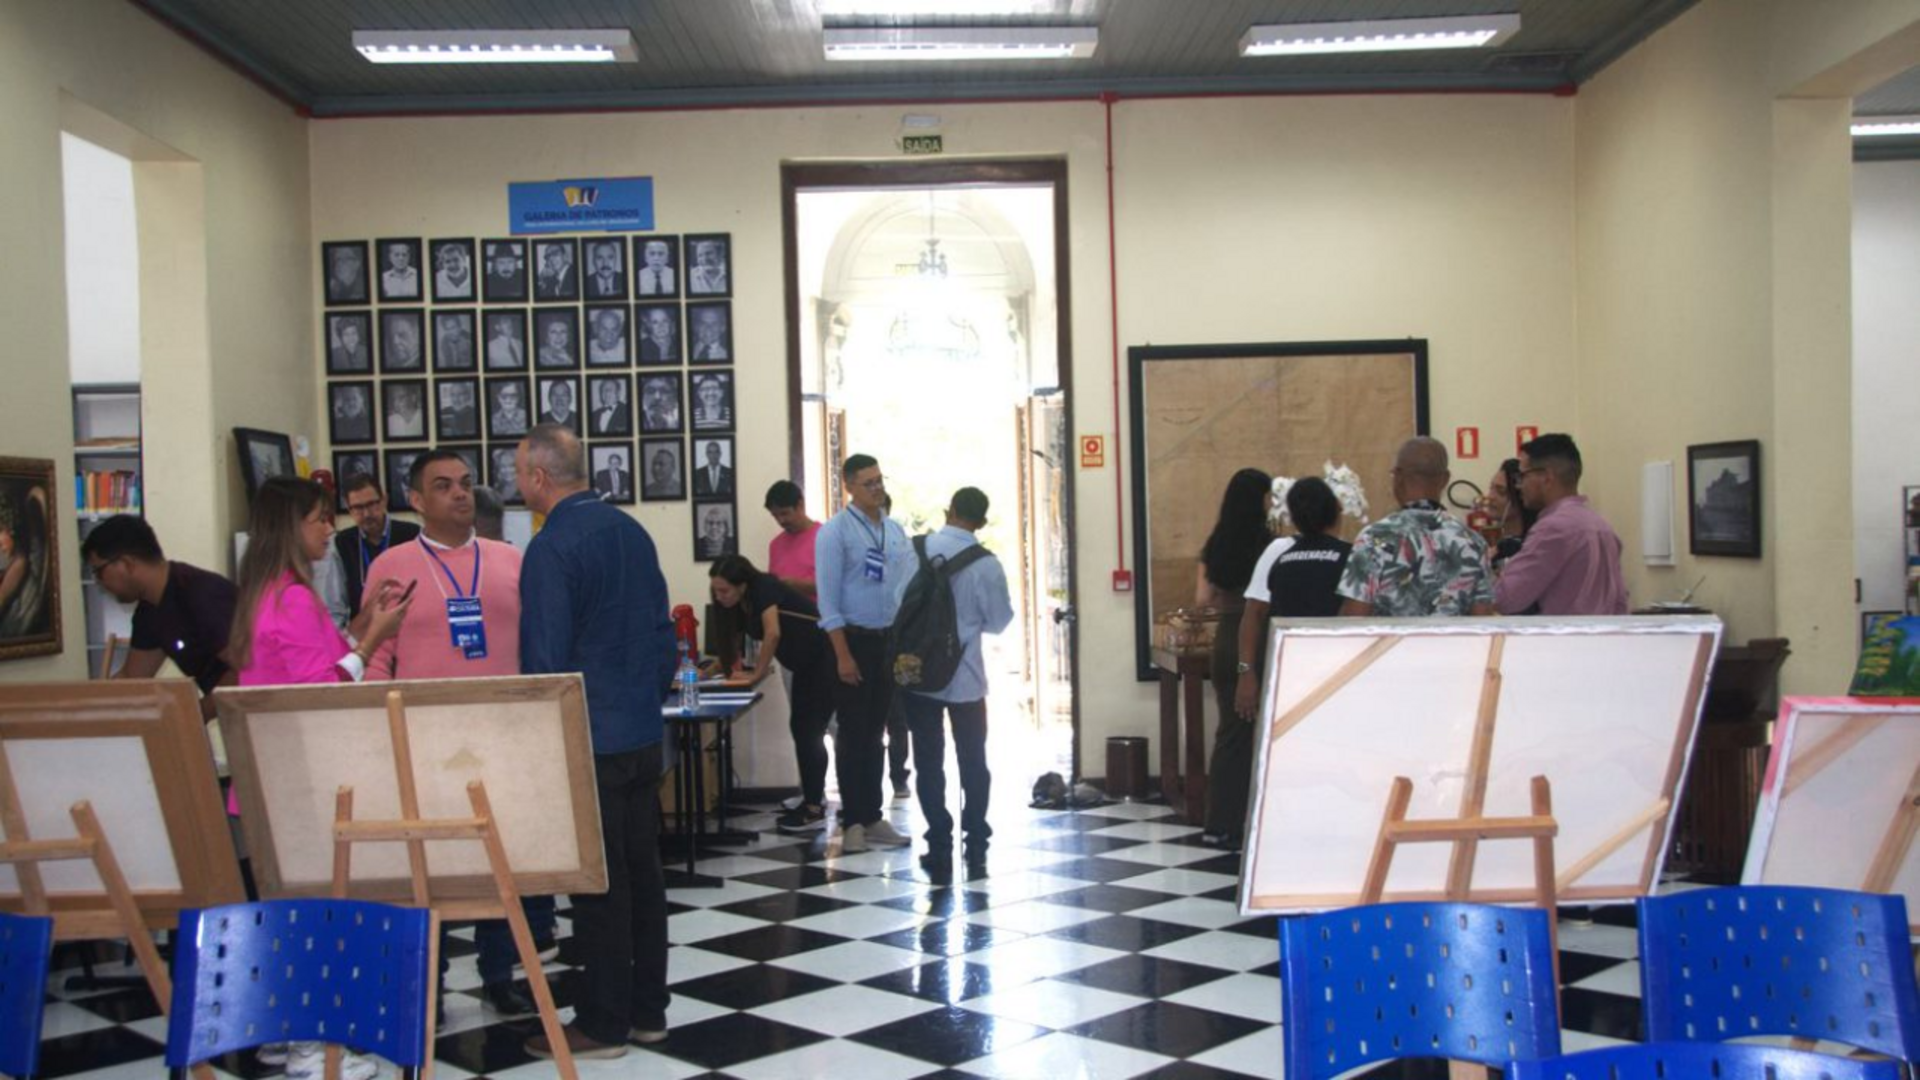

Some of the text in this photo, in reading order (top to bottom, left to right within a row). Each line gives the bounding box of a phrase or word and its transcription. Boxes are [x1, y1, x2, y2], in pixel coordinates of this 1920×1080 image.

[905, 138, 940, 153] SAÍDA
[523, 207, 639, 222] GALERIA DE PATRONOS
[1279, 549, 1341, 564] COORDENAÇÃO
